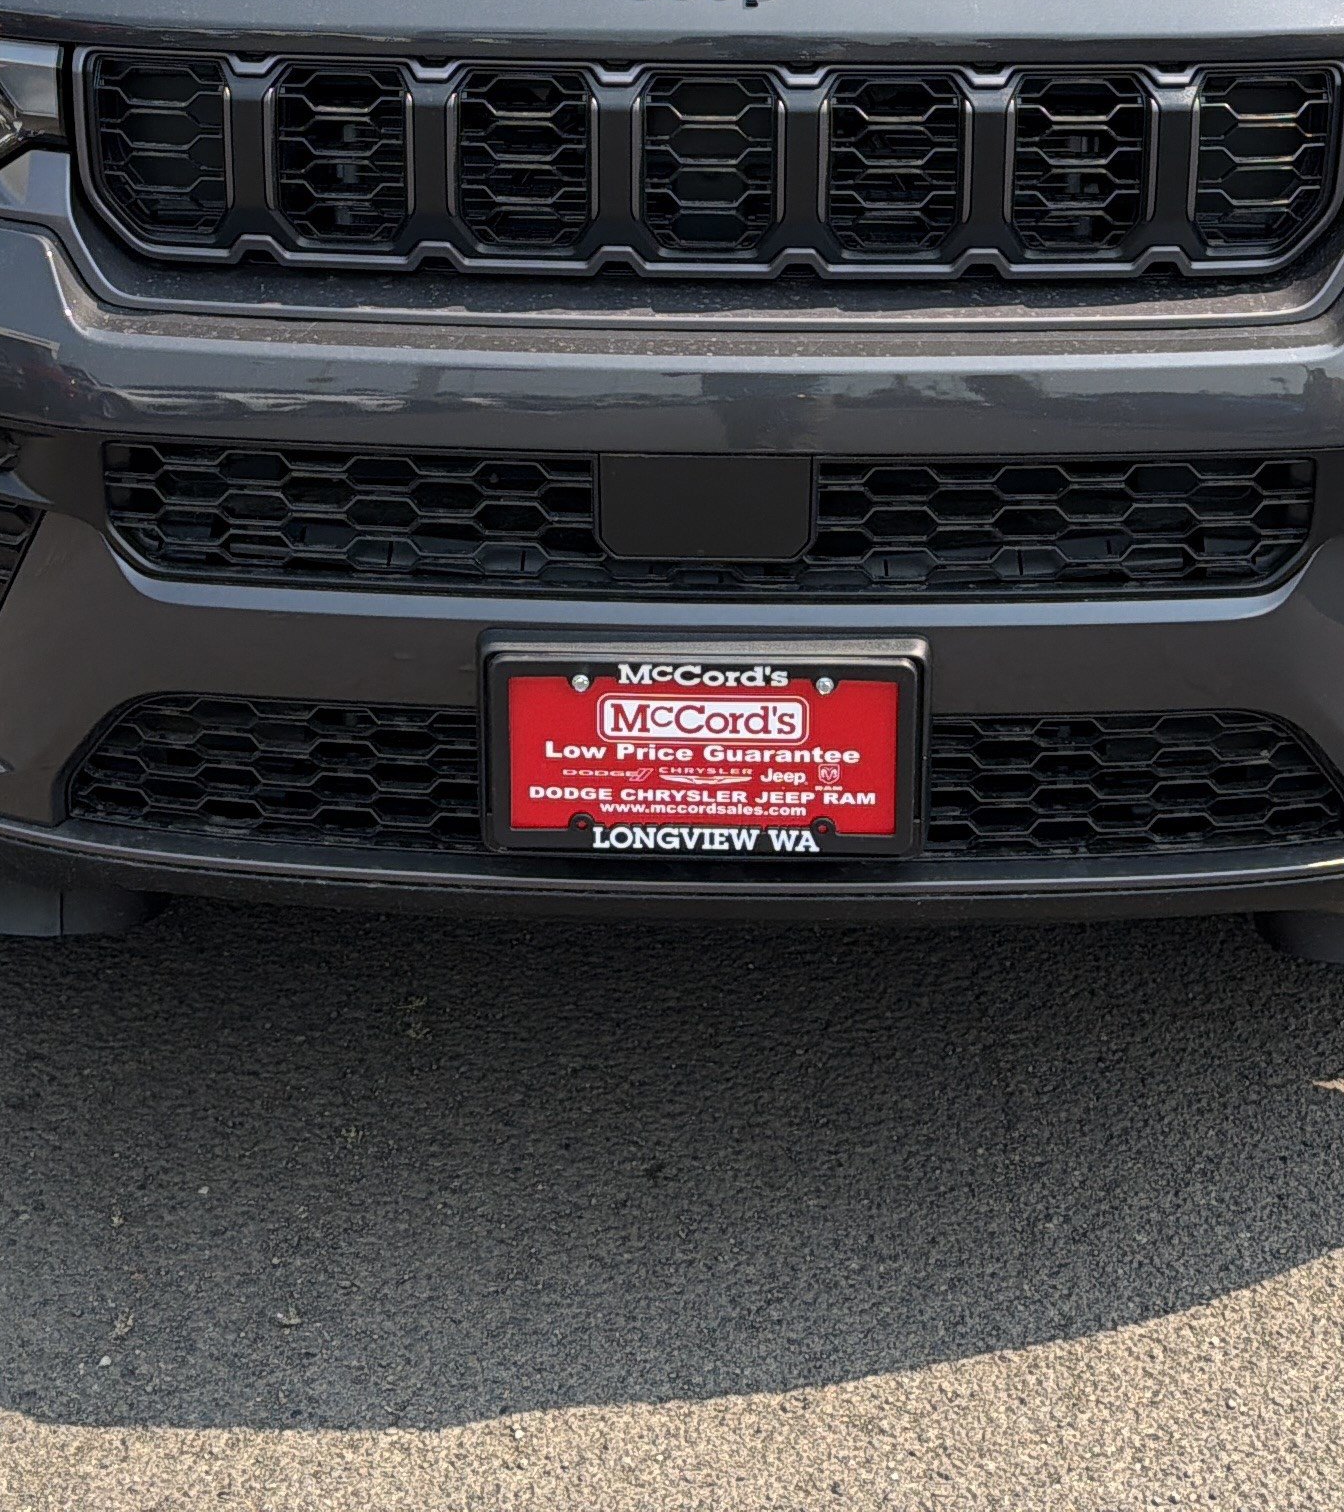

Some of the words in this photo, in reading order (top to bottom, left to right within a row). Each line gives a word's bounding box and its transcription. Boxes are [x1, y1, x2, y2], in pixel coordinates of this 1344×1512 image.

[617, 663, 789, 688] McCord's
[610, 703, 796, 735] McCord's
[545, 740, 607, 759] Low
[616, 743, 693, 762] Price
[703, 745, 861, 764] Guarantee
[562, 769, 638, 777] DODGE
[658, 766, 753, 776] CHRYSLER
[760, 768, 807, 786] Jeep
[529, 786, 613, 800] DODGE
[620, 788, 748, 803] CHRYSLER
[755, 791, 815, 804] JEEP
[823, 792, 877, 805] RAM
[600, 802, 807, 817] www.mccordsales.com
[592, 825, 760, 851] LONGVIEW
[768, 829, 821, 853] WA
